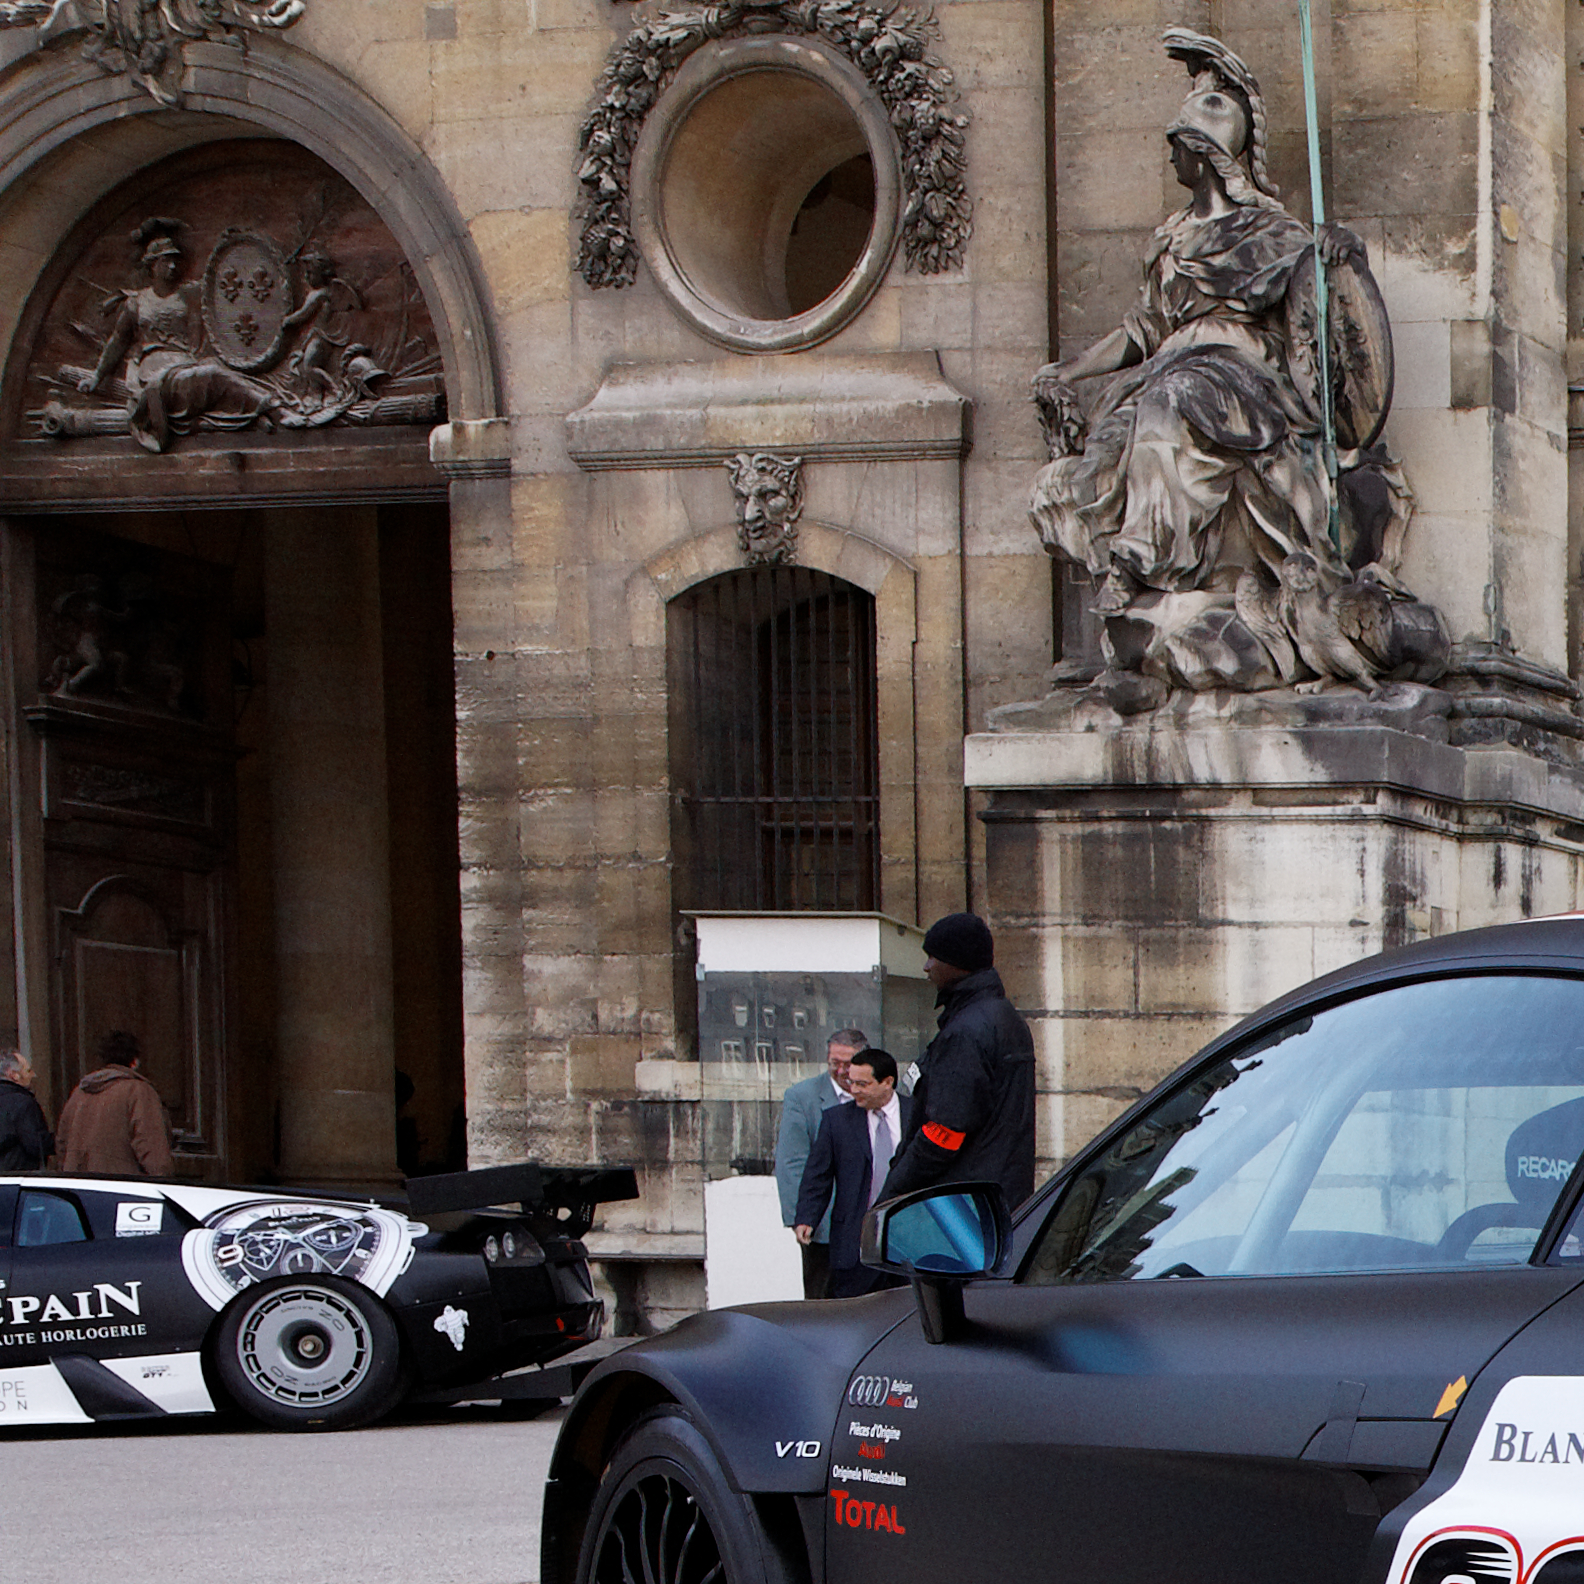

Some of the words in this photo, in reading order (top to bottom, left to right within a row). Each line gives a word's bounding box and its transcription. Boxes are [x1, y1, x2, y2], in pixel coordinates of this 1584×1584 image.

[0, 1281, 142, 1325] PAIN
[41, 1323, 147, 1343] HORLOGERIE
[0, 1380, 26, 1398] PE
[775, 1440, 820, 1458] V10
[858, 1440, 886, 1459] Audi
[830, 1488, 906, 1535] TOTAL
